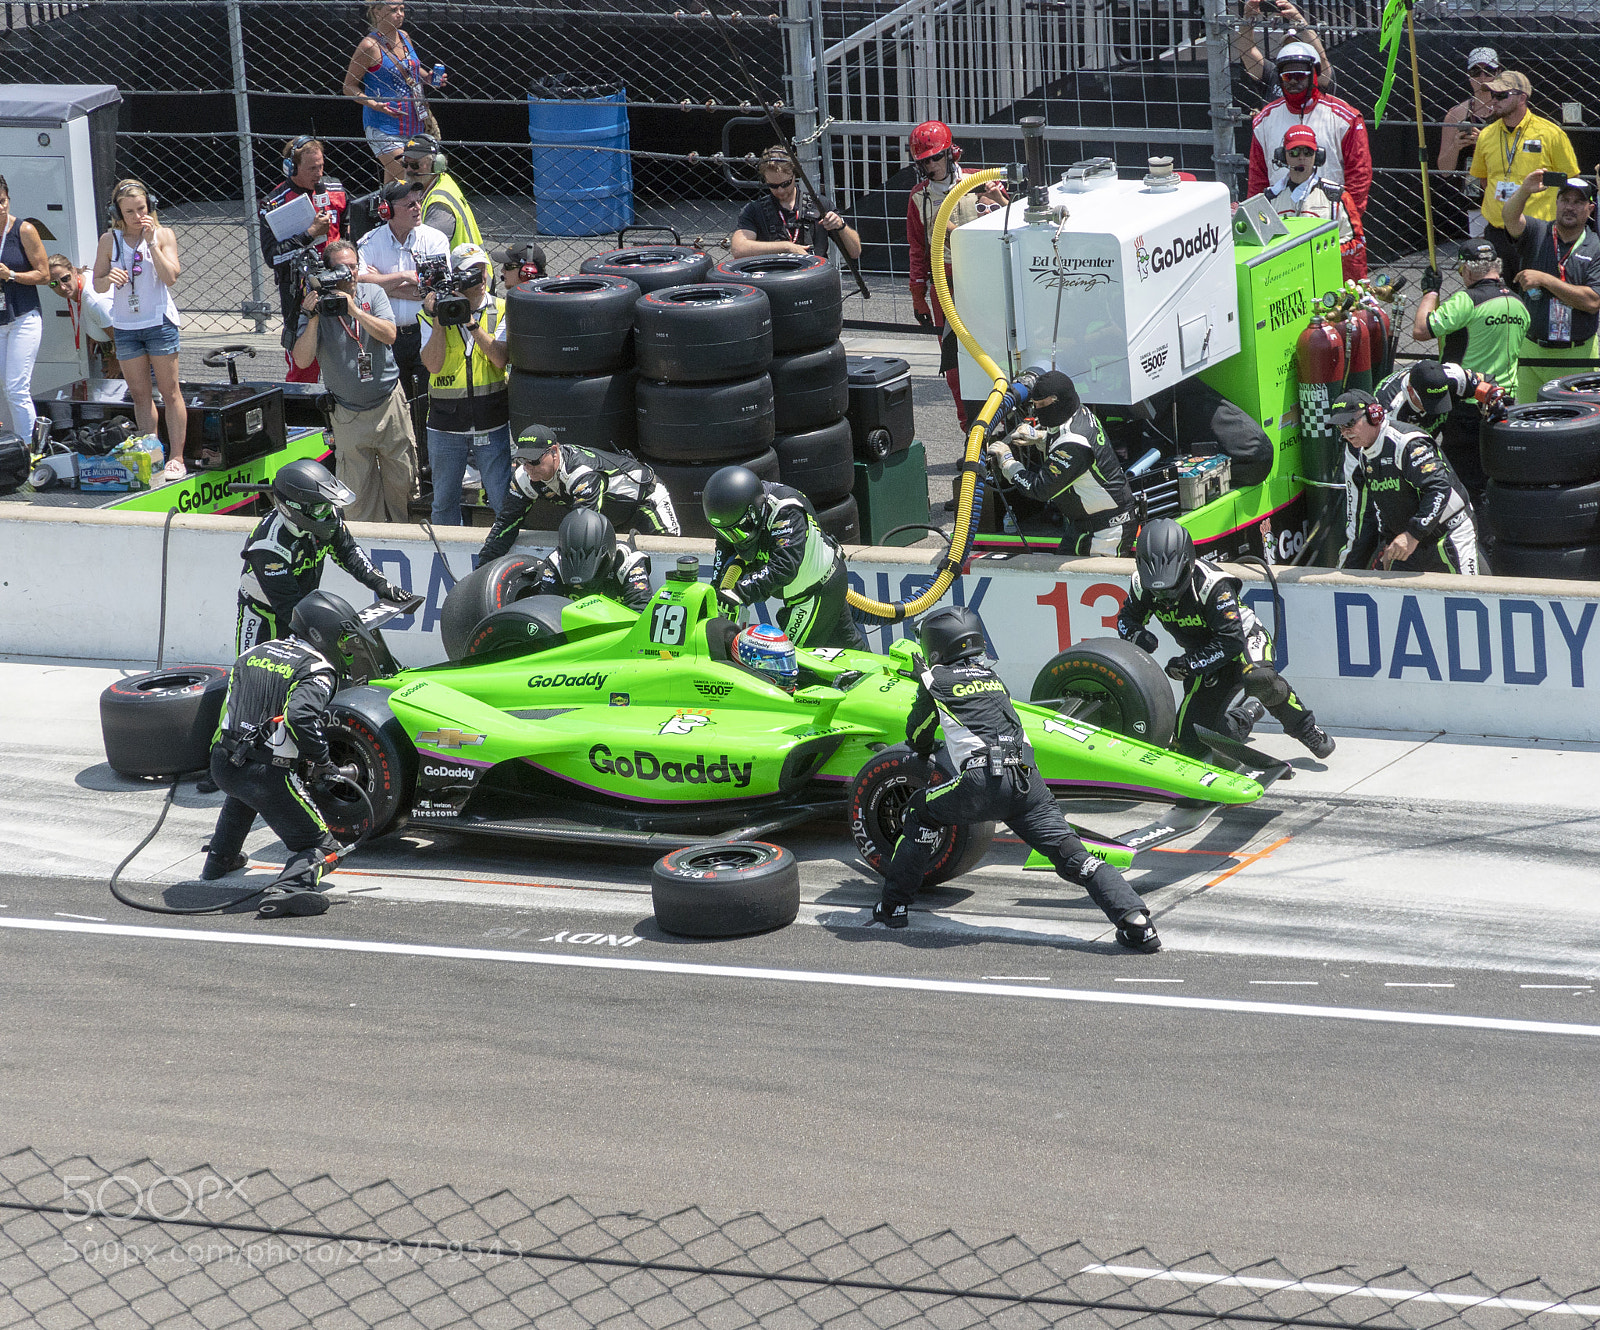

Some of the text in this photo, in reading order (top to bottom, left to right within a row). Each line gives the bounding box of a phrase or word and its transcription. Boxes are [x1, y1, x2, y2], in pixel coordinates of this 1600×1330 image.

[1151, 223, 1219, 274] GoDaddy
[1032, 255, 1115, 271] Ed Carpenter
[1269, 287, 1304, 317] PRETTY
[1270, 300, 1308, 332] INTENSE
[1485, 314, 1525, 329] GoDaddy
[81, 469, 92, 477] ICE
[178, 470, 251, 513] GoDaddy
[1420, 491, 1446, 526] GoDaddy
[654, 604, 685, 645] 13
[1333, 591, 1598, 688] DADDY
[247, 655, 295, 679] GoDaddy
[1190, 649, 1225, 670] GoDaddy
[527, 671, 609, 691] GoDaddy
[1051, 660, 1125, 687] Firestone
[400, 682, 428, 698] GoDaddy
[703, 685, 725, 695] 500
[952, 679, 1007, 697] GoDaddy
[347, 718, 390, 790] Firestone
[588, 743, 752, 788] GoDaddy
[424, 765, 475, 780] GoDaddy
[852, 759, 899, 820] Firestone
[411, 809, 458, 818] Firestone
[538, 930, 646, 947] INDY
